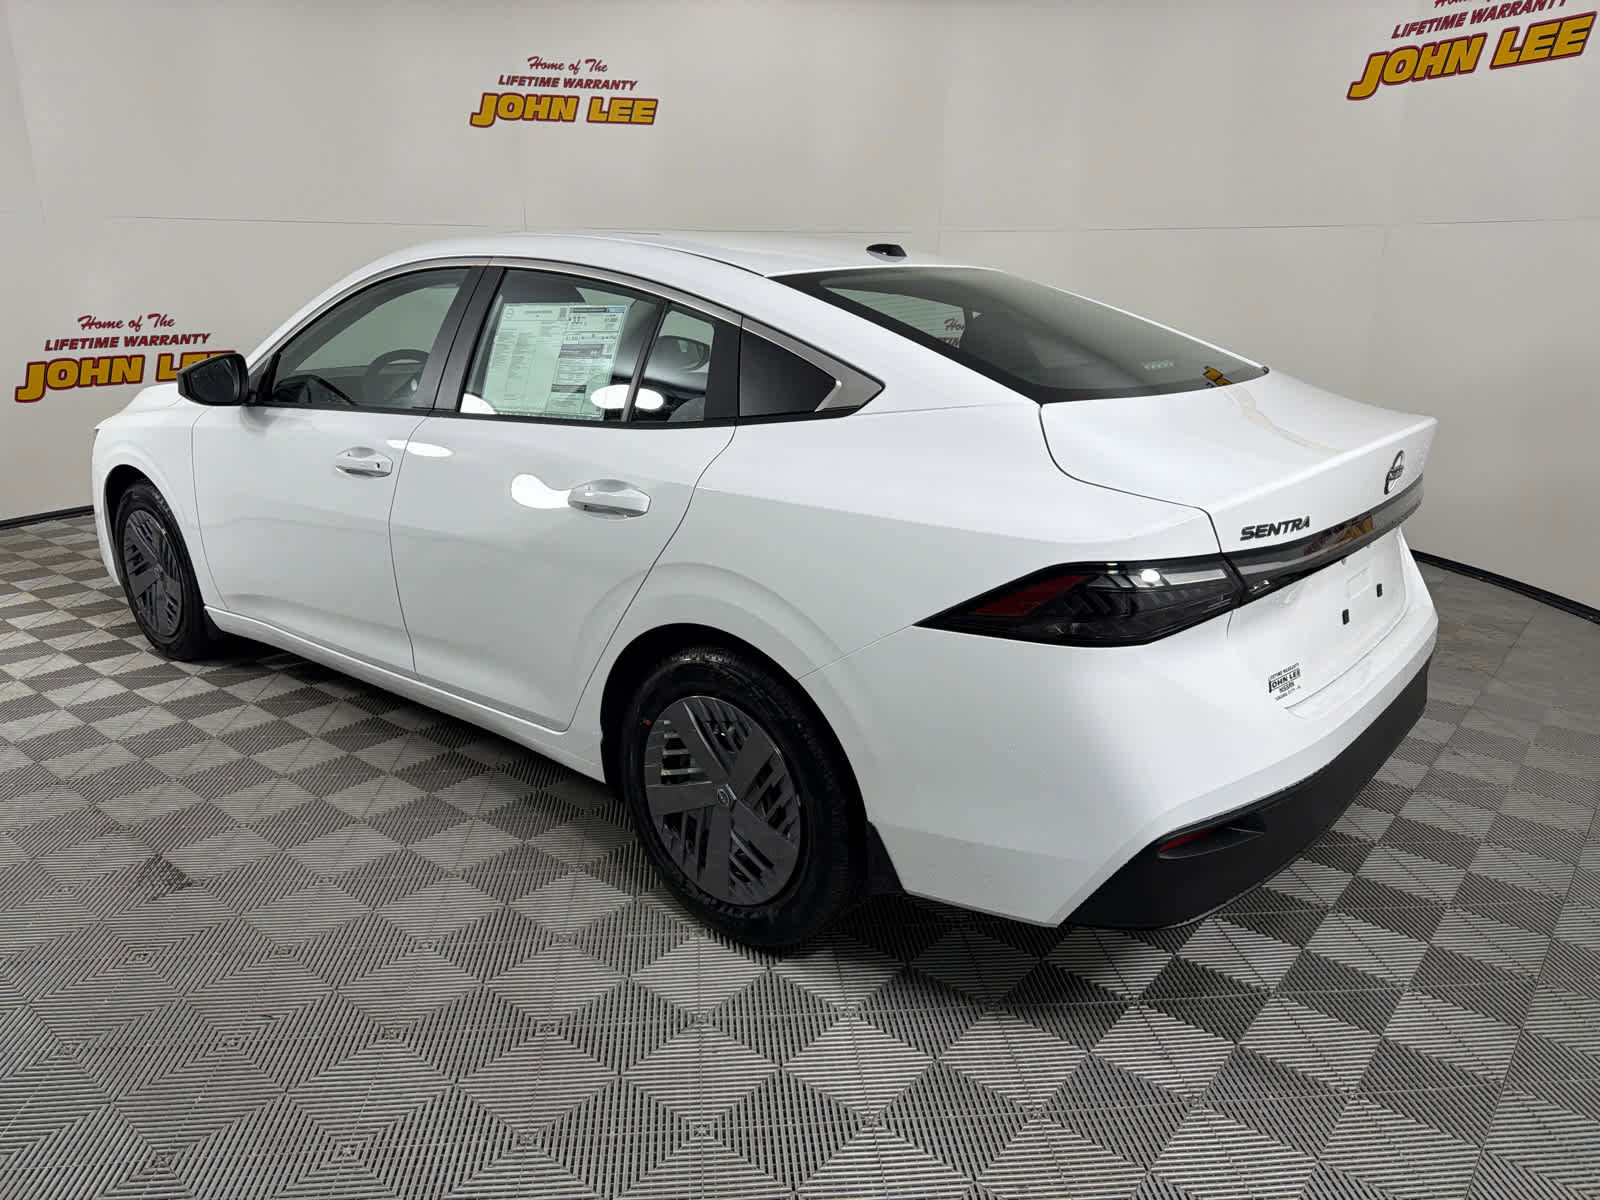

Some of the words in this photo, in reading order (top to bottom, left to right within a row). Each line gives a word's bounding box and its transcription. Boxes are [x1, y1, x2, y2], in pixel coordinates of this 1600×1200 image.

[1391, 12, 1468, 39] LIFETIME
[527, 56, 565, 71] Home
[568, 58, 581, 75] of
[585, 58, 608, 73] The
[1346, 32, 1488, 100] JOHN
[1489, 11, 1598, 70] LEE
[498, 75, 560, 88] LIFETIME
[563, 76, 638, 91] WARRANTY
[469, 93, 580, 128] JOHN
[586, 96, 658, 126] LEE
[77, 315, 125, 330] Home
[128, 316, 144, 333] of
[147, 313, 175, 329] The
[44, 336, 120, 351] LIFETIME
[123, 333, 211, 348] WARRANTY
[14, 354, 145, 403] JOHN
[1239, 515, 1311, 541] SENTRA
[1268, 676, 1288, 693] JOHN
